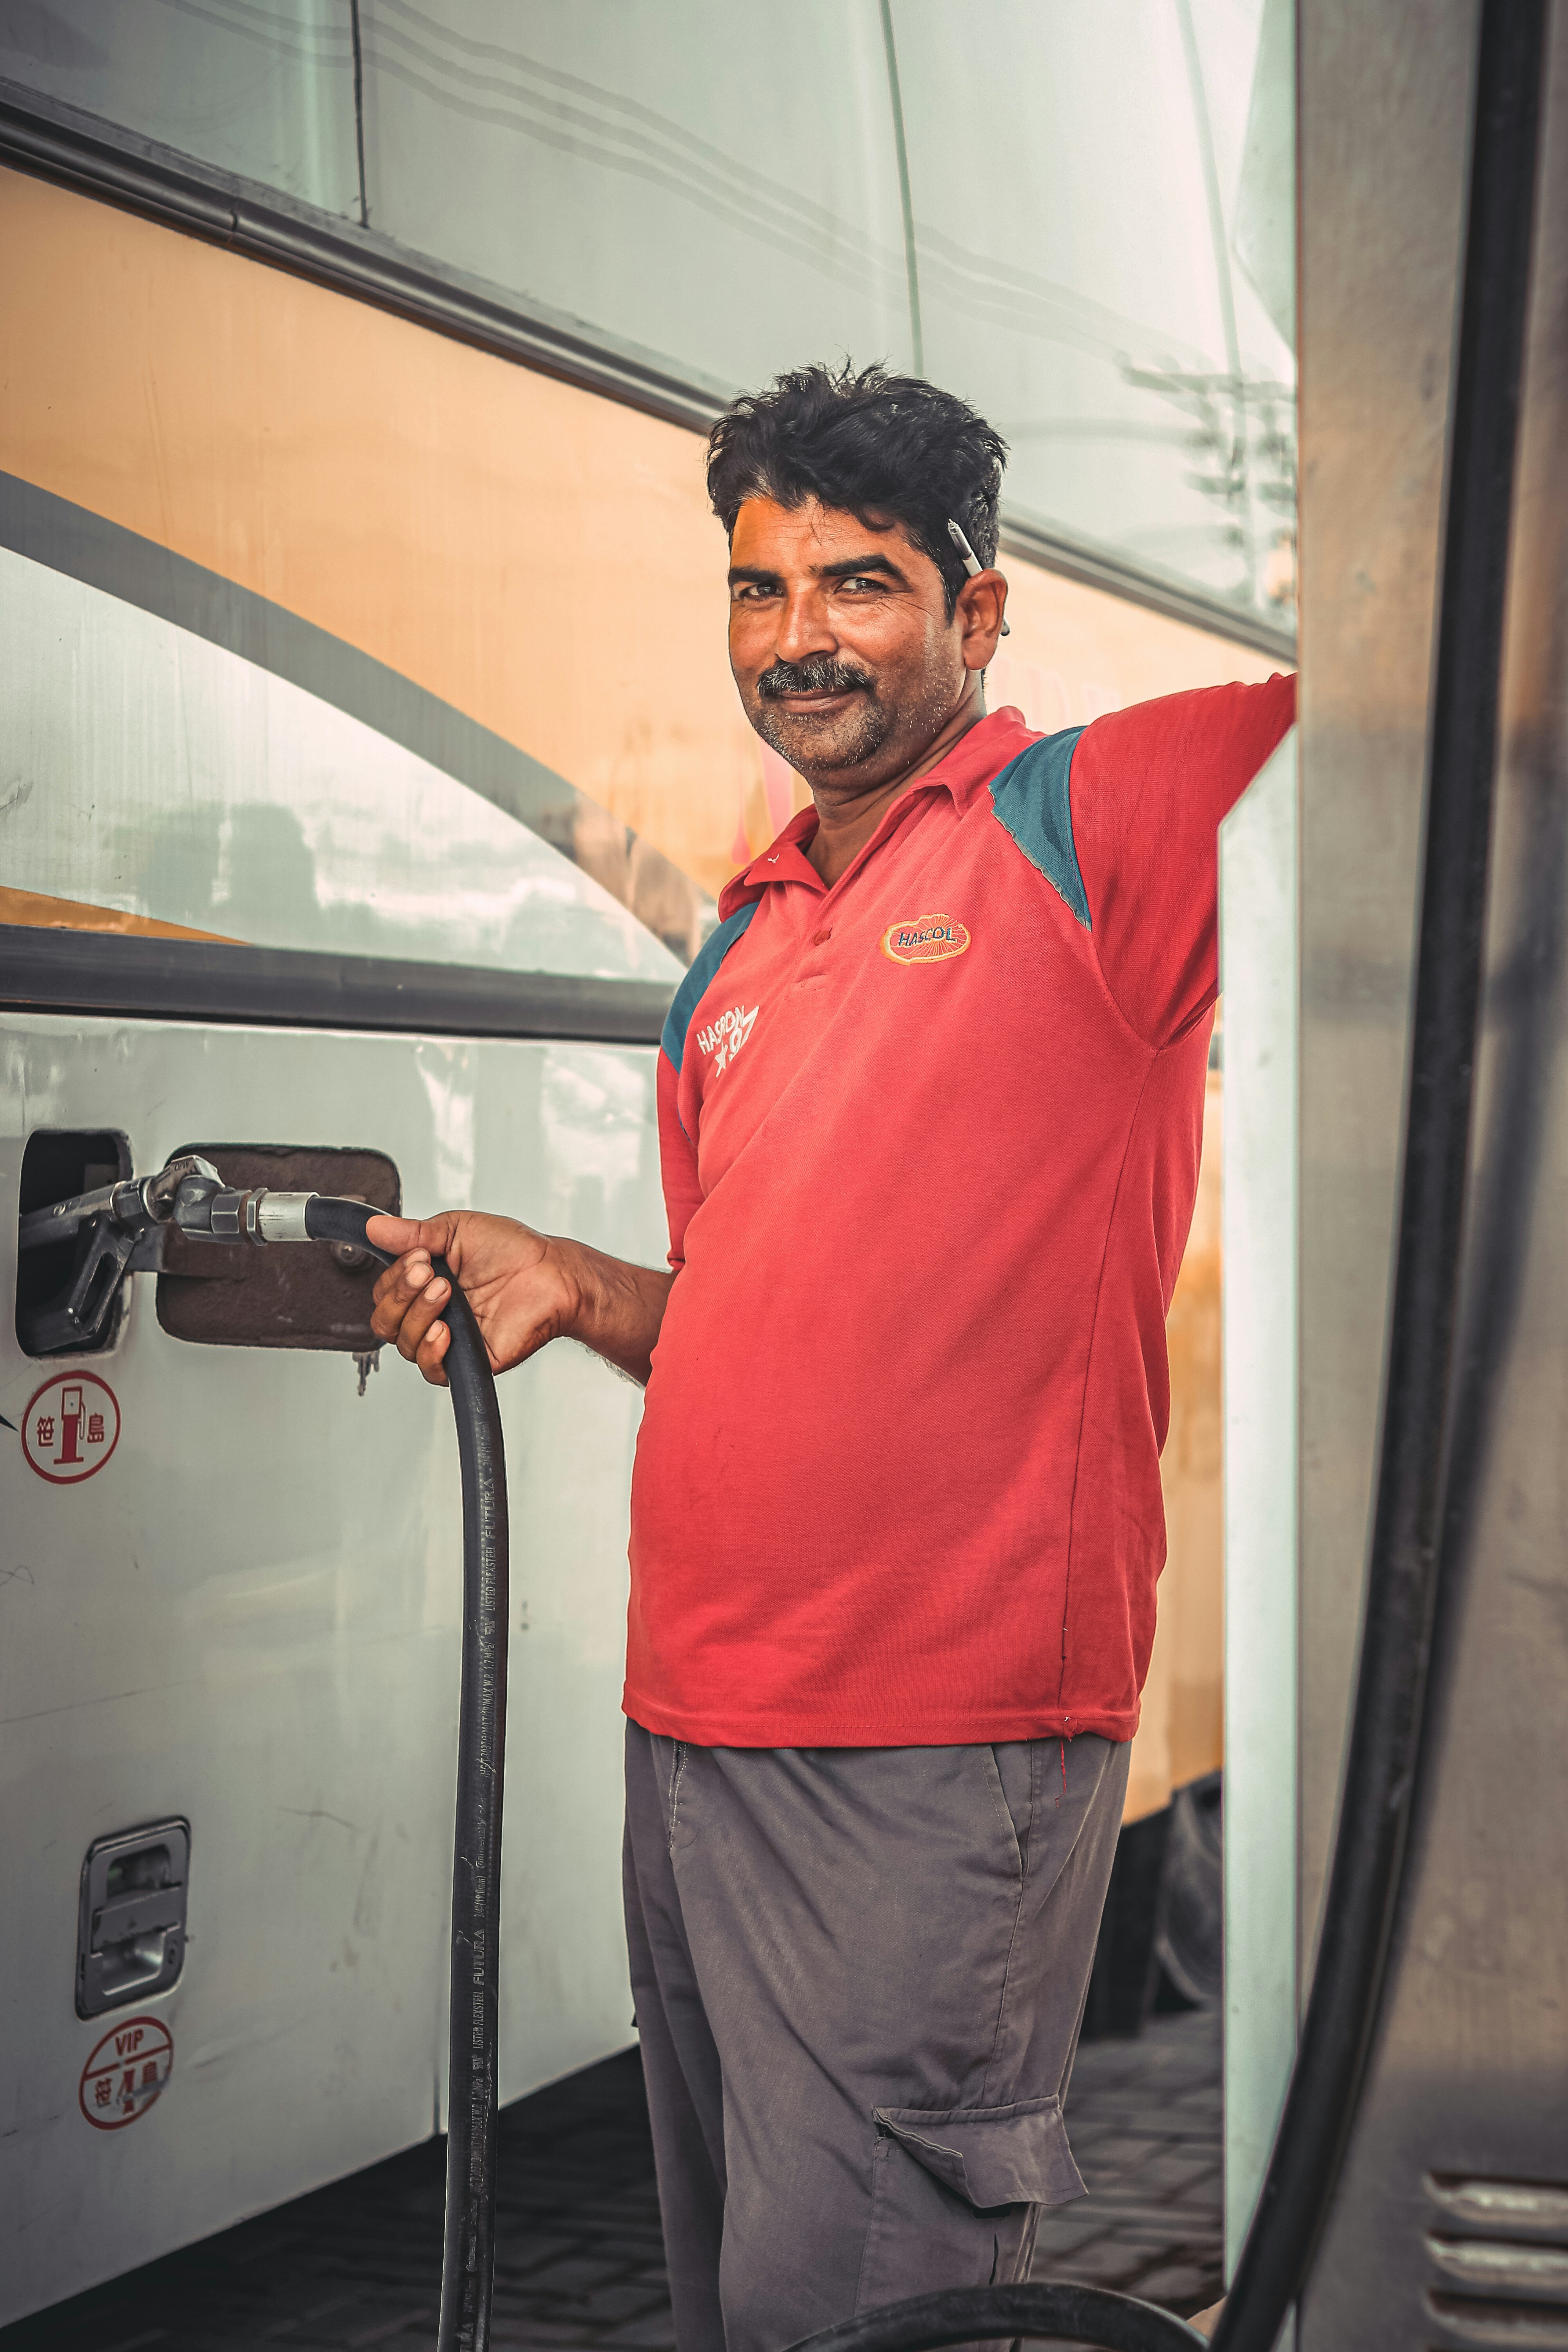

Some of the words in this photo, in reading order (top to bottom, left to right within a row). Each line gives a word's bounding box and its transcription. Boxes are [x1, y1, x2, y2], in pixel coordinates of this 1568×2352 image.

[897, 926, 958, 948] HASCOL
[484, 1477, 496, 1539] FUTURA
[485, 1546, 496, 1584] FLEXSTEEL
[485, 1586, 496, 1611] LISTED
[473, 1929, 485, 1985] FUTURA
[473, 1991, 484, 2025] FLEXSTEEL
[116, 2029, 143, 2055] VIP
[472, 2027, 484, 2049] LISTED
